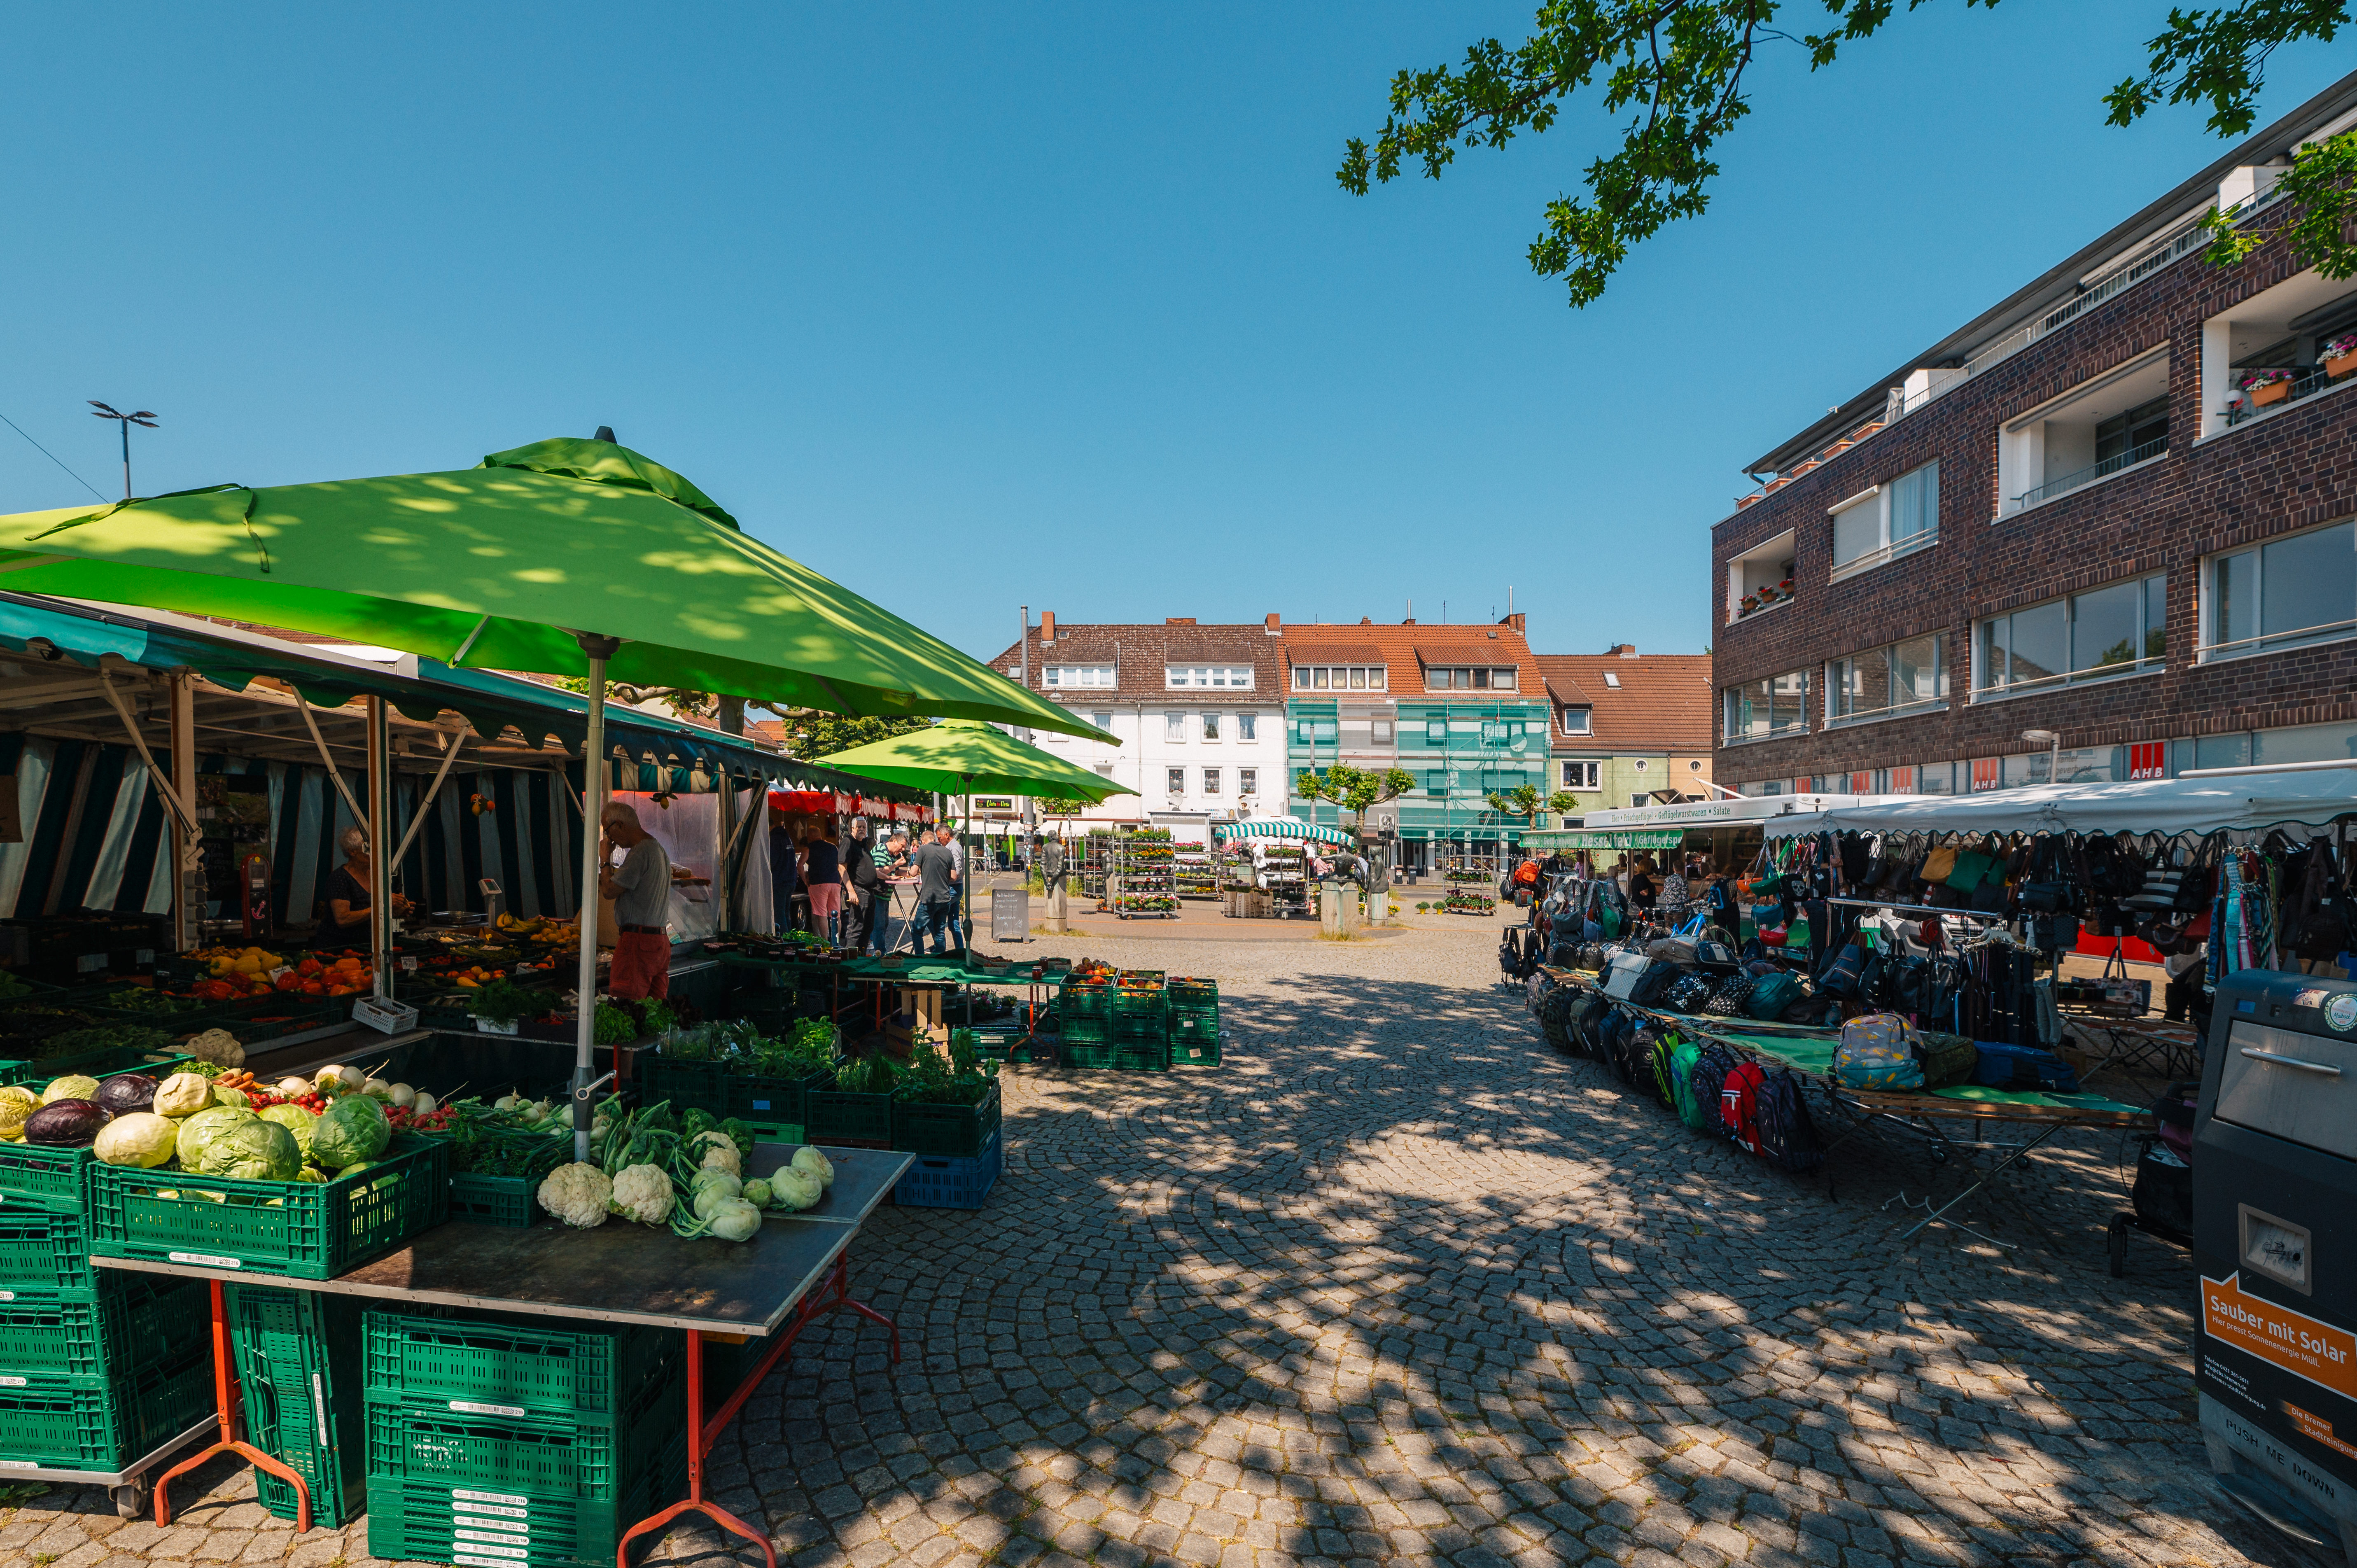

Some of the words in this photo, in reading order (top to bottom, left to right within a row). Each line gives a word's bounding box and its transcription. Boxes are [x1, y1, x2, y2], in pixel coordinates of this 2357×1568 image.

[2039, 755, 2078, 765] Amlanter
[2130, 767, 2163, 779] AHB
[1894, 786, 1911, 794] AHB
[1974, 780, 1997, 790] AHB
[1624, 812, 1653, 823] Frischgeflügel
[1658, 809, 1707, 821] Geflügelwurstwaren
[1713, 806, 1730, 815] Salate
[2210, 1295, 2264, 1329] Sauber
[2268, 1321, 2296, 1344] mit
[2300, 1331, 2347, 1364] Solar
[2212, 1315, 2225, 1326] Hier
[2227, 1322, 2247, 1336] presst
[2248, 1330, 2299, 1358] Sonnenenergie
[2301, 1353, 2320, 1367] Müll.
[2204, 1355, 2219, 1367] Telefon
[2220, 1364, 2230, 1373] 0421
[2231, 1370, 2249, 1385] 361-3611
[2204, 1362, 2247, 1391] info@dbs.bremen.de
[2205, 1370, 2266, 1410] die-bremer-stadtreinigung.de
[2292, 1407, 2303, 1419] Die
[2304, 1414, 2331, 1432] Bremer
[2304, 1425, 2357, 1459] Stadtreinigung
[2226, 1419, 2258, 1448] PUSH
[2266, 1444, 2285, 1466] ME
[2293, 1463, 2334, 1499] DOWN
